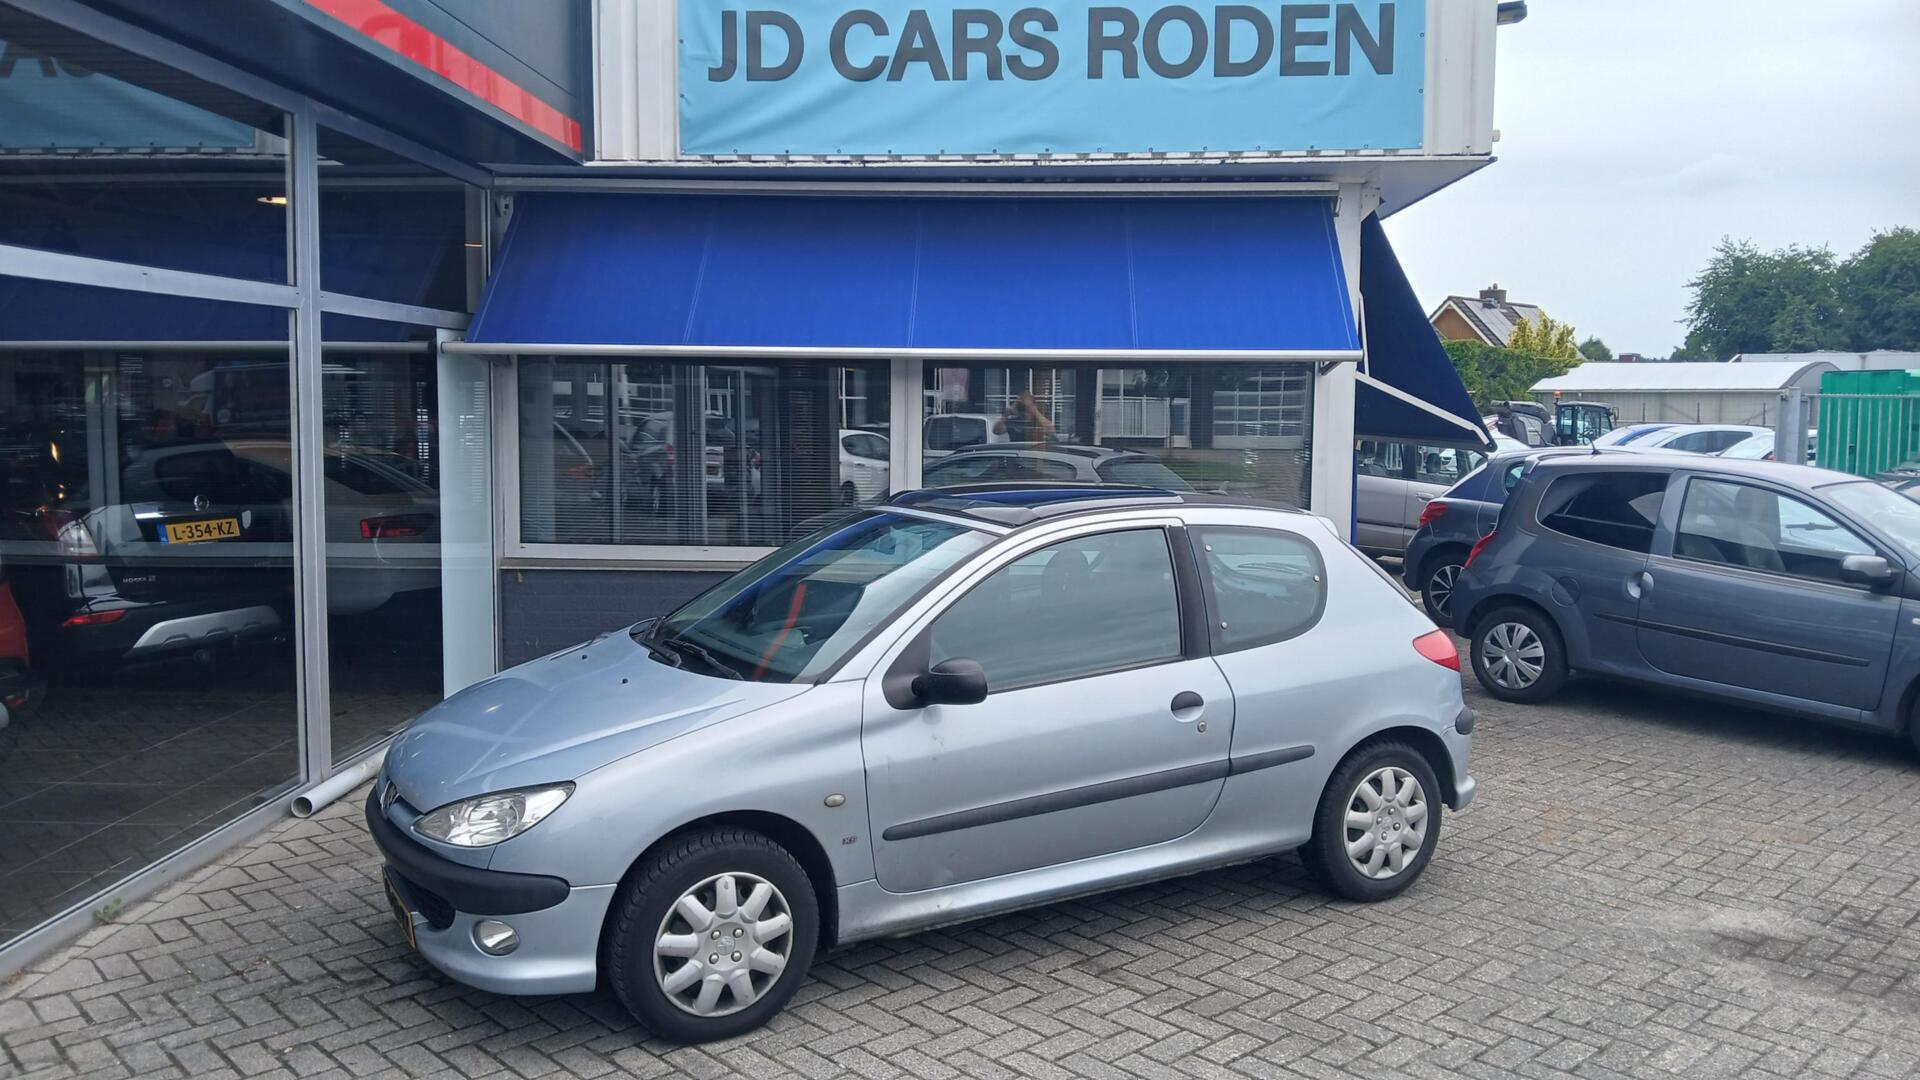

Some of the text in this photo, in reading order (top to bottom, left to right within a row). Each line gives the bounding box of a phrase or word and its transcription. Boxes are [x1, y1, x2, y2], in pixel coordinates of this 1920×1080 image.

[708, 2, 1395, 82] JD CARS RODEN
[173, 521, 235, 541] L-354-KZ
